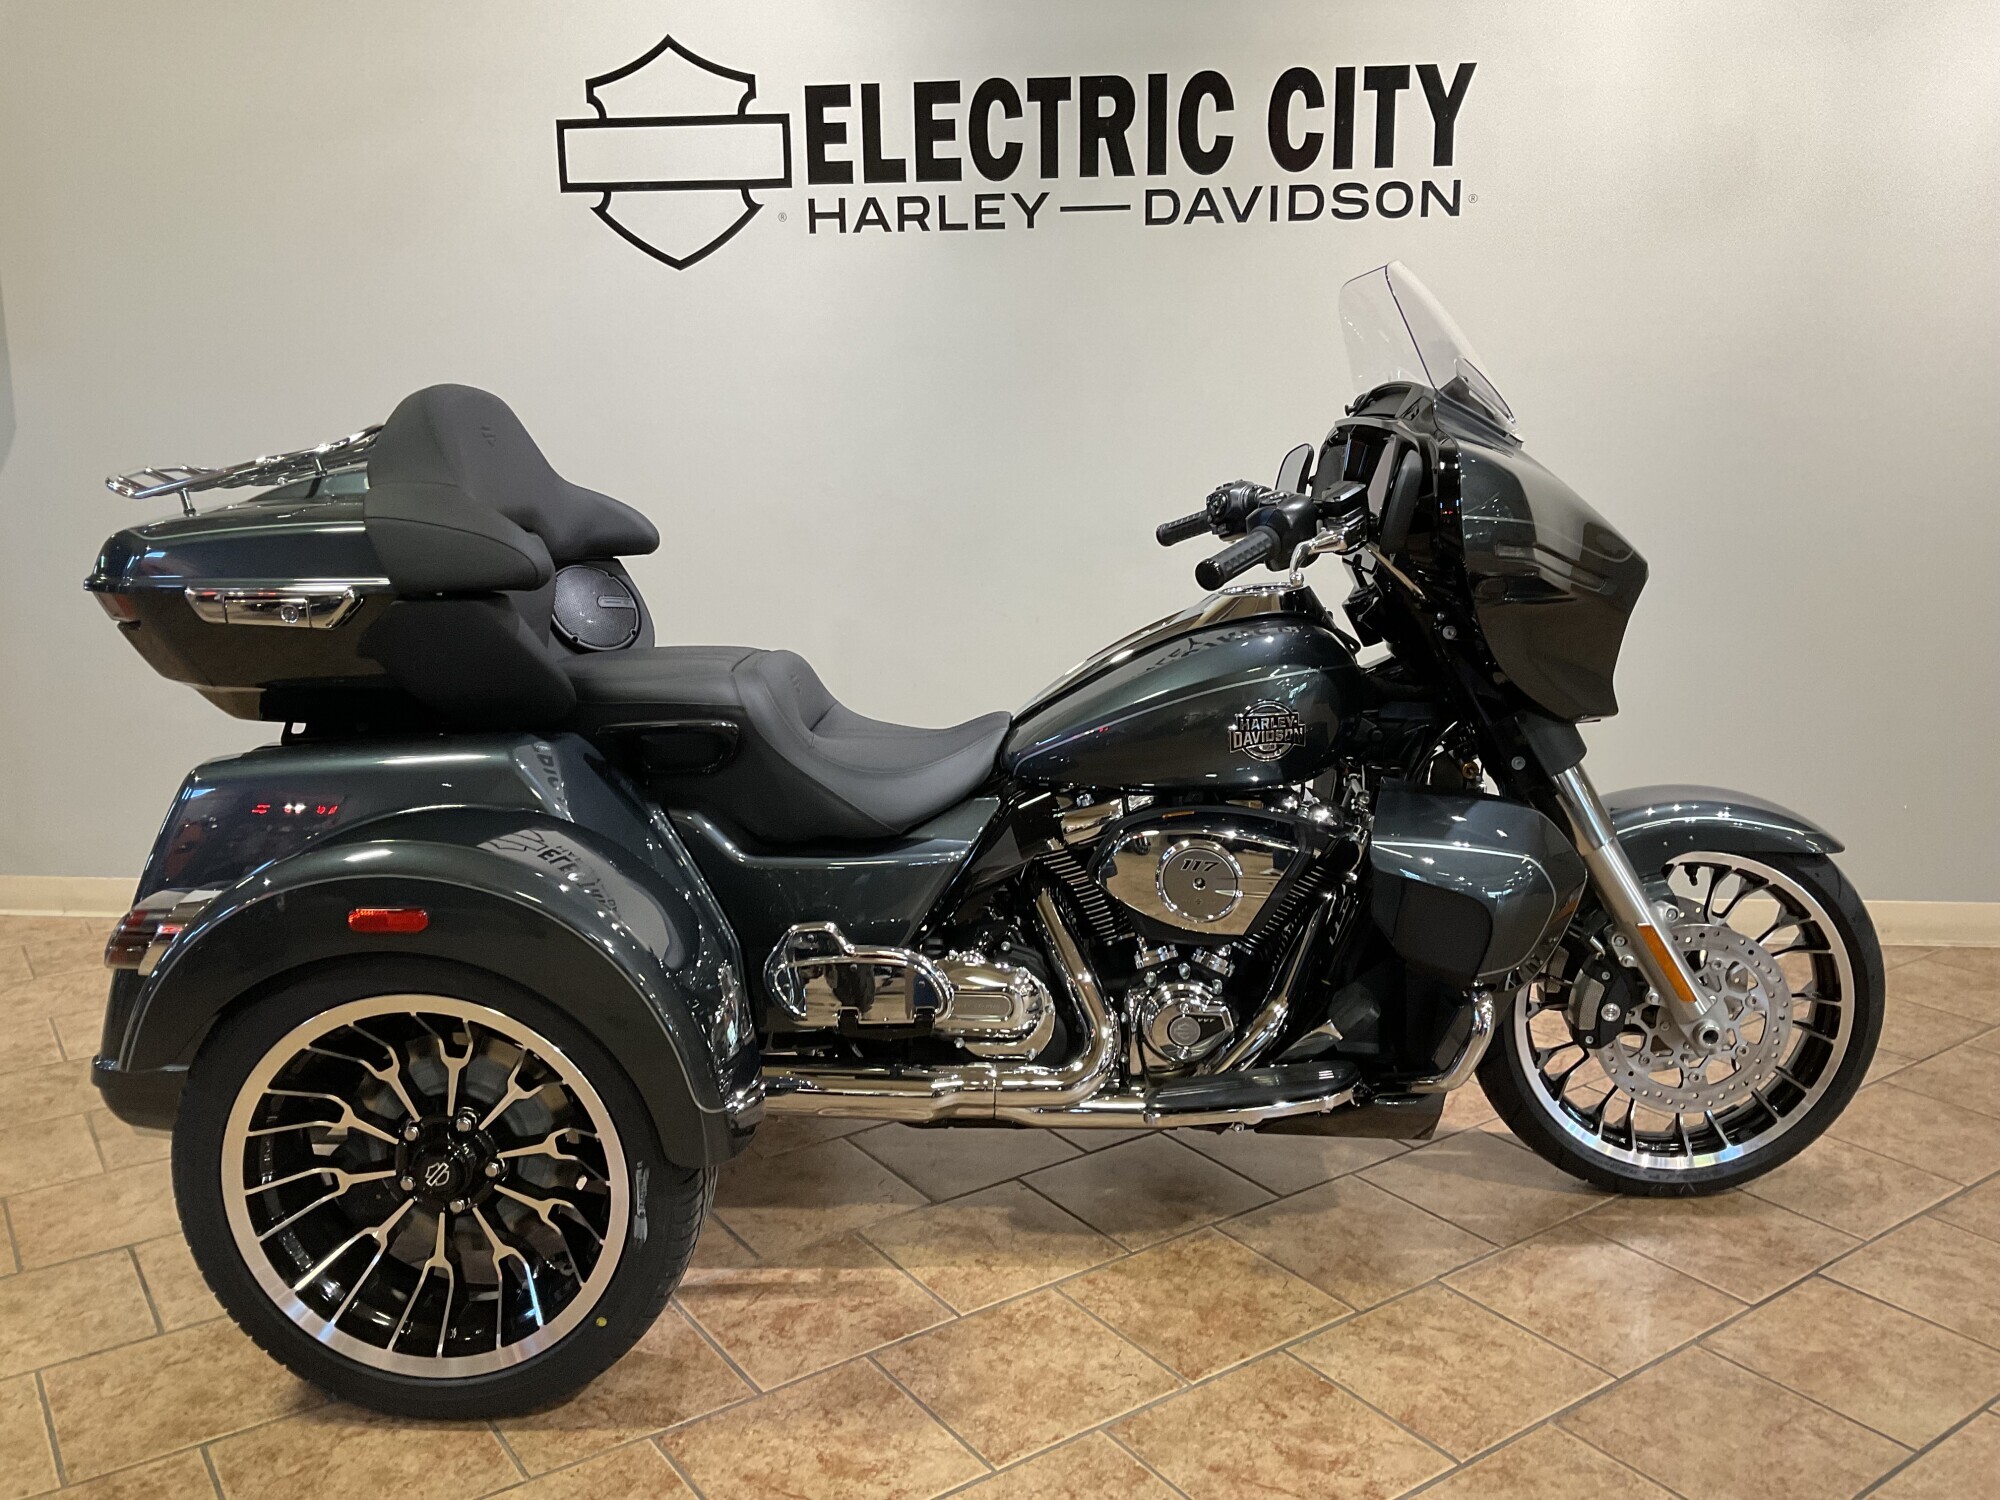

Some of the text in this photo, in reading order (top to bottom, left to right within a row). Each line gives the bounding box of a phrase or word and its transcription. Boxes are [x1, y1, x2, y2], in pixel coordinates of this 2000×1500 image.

[804, 62, 1478, 185] ELECTRIC CITY
[807, 179, 1462, 234] HARLEY DAVIDSON
[1233, 727, 1303, 749] DAVIDSON
[1181, 859, 1221, 872] 117
